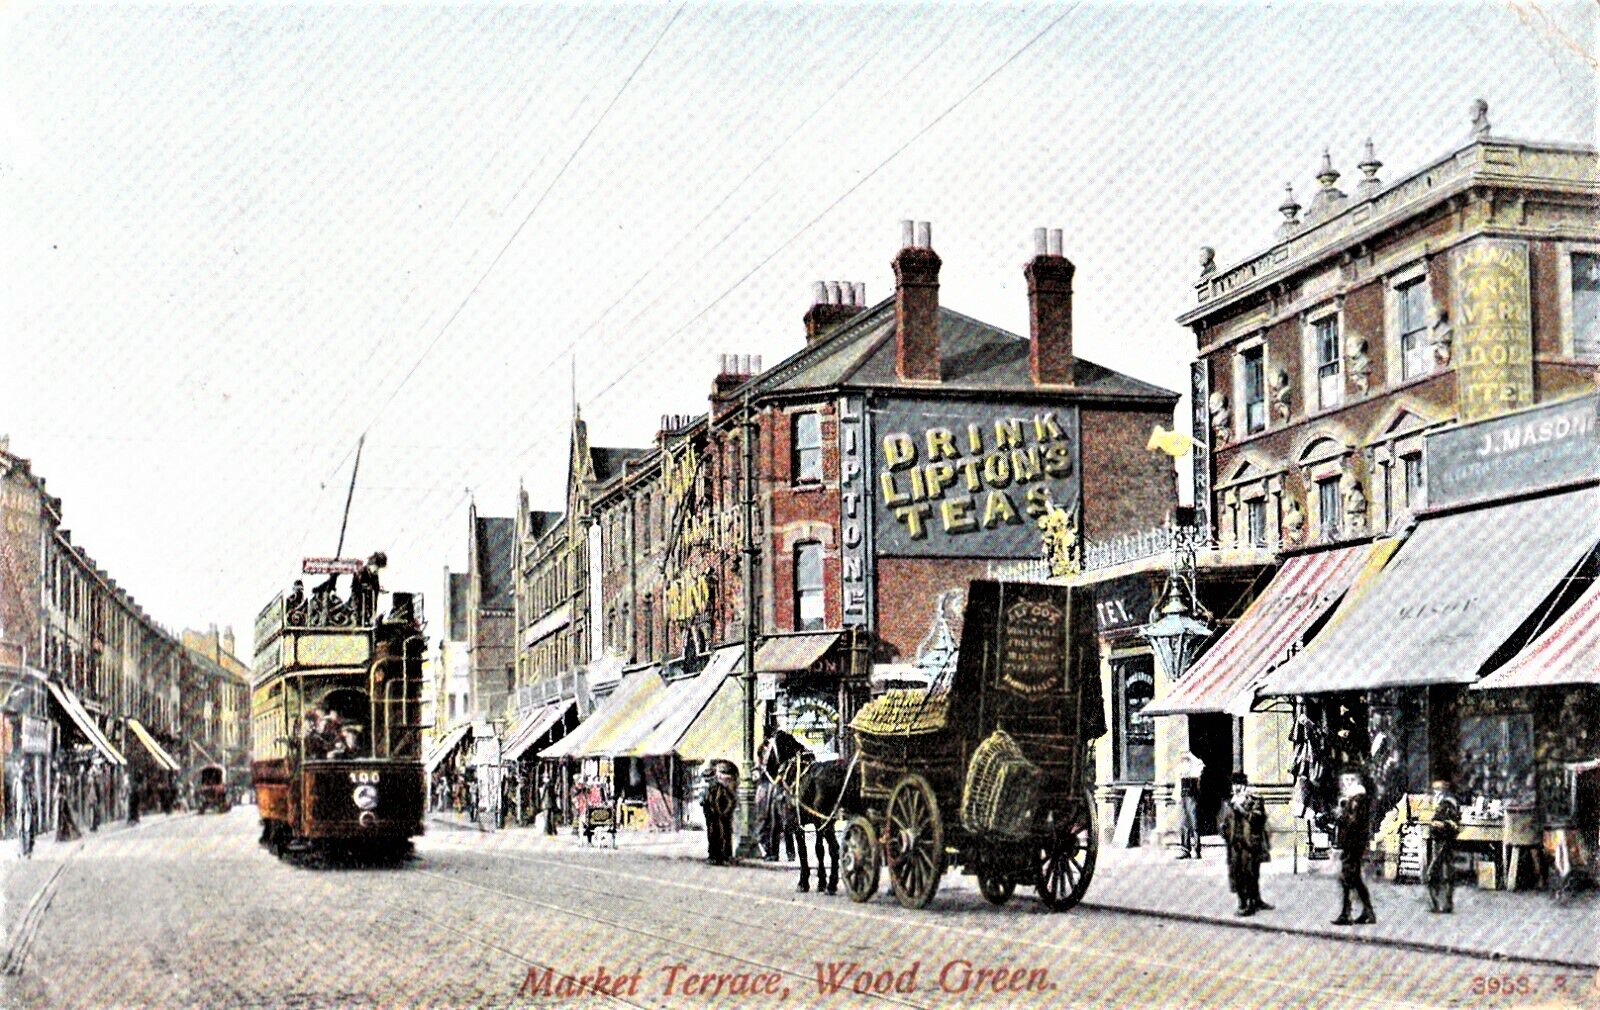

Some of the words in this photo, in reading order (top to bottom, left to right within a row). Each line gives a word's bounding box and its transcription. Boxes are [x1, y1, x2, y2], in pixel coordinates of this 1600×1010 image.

[882, 411, 1070, 471] DRINK
[880, 442, 1073, 508] LIPTON'S
[895, 482, 1053, 541] TEAS
